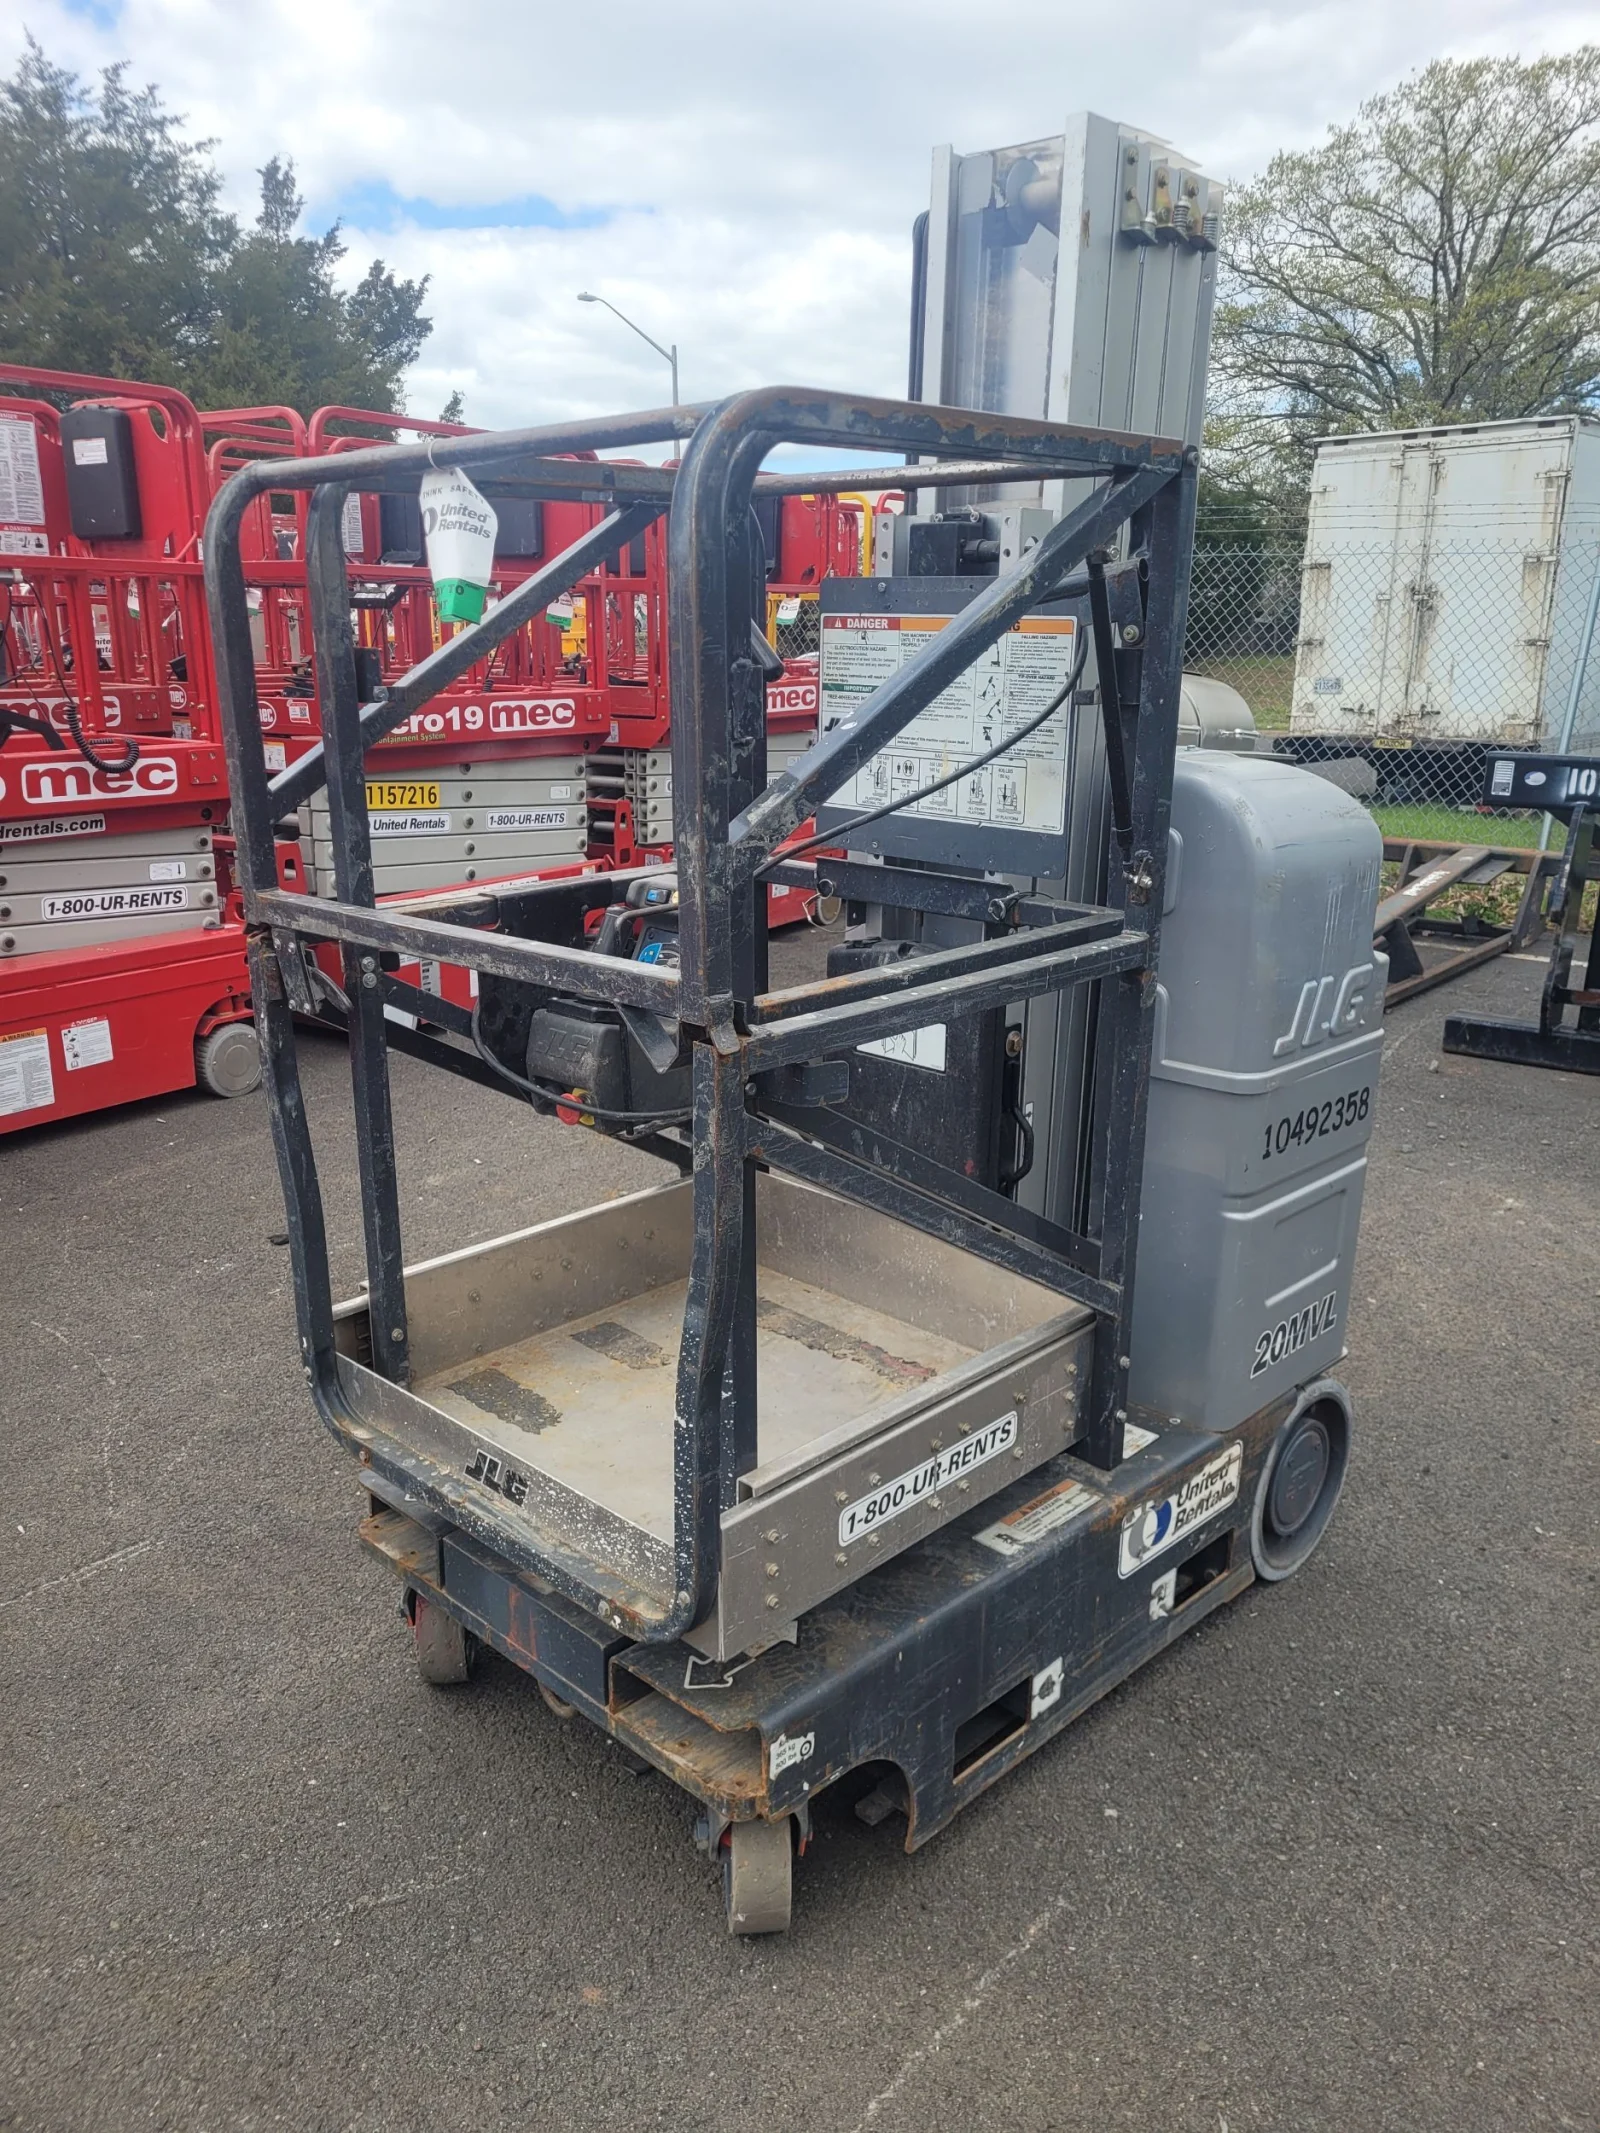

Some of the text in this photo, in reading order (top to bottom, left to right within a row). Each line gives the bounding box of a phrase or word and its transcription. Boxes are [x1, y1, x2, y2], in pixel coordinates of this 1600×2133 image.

[423, 484, 485, 504] THINK SAFETY
[440, 503, 488, 523] United
[438, 518, 491, 539] Rentals
[847, 618, 888, 629] DANGER
[767, 688, 815, 709] mec
[491, 702, 576, 728] mec
[377, 732, 446, 744] ontainment System
[25, 763, 176, 799] mec
[0, 818, 104, 839] drentals.com
[374, 817, 446, 831] United Rentals
[489, 812, 565, 826] 1-800-UR-RENTS
[48, 889, 183, 916] 1-800-UR-RENTS
[1273, 963, 1374, 1058] JLG
[8, 1031, 35, 1041] WARNING
[536, 1027, 592, 1062] JLG
[1262, 1086, 1370, 1161] 10492358
[1250, 1291, 1337, 1379] 20MVL
[463, 1448, 529, 1508] JLG
[846, 1418, 1013, 1536] 1-800-UR-RENTS
[1177, 1453, 1234, 1508] United
